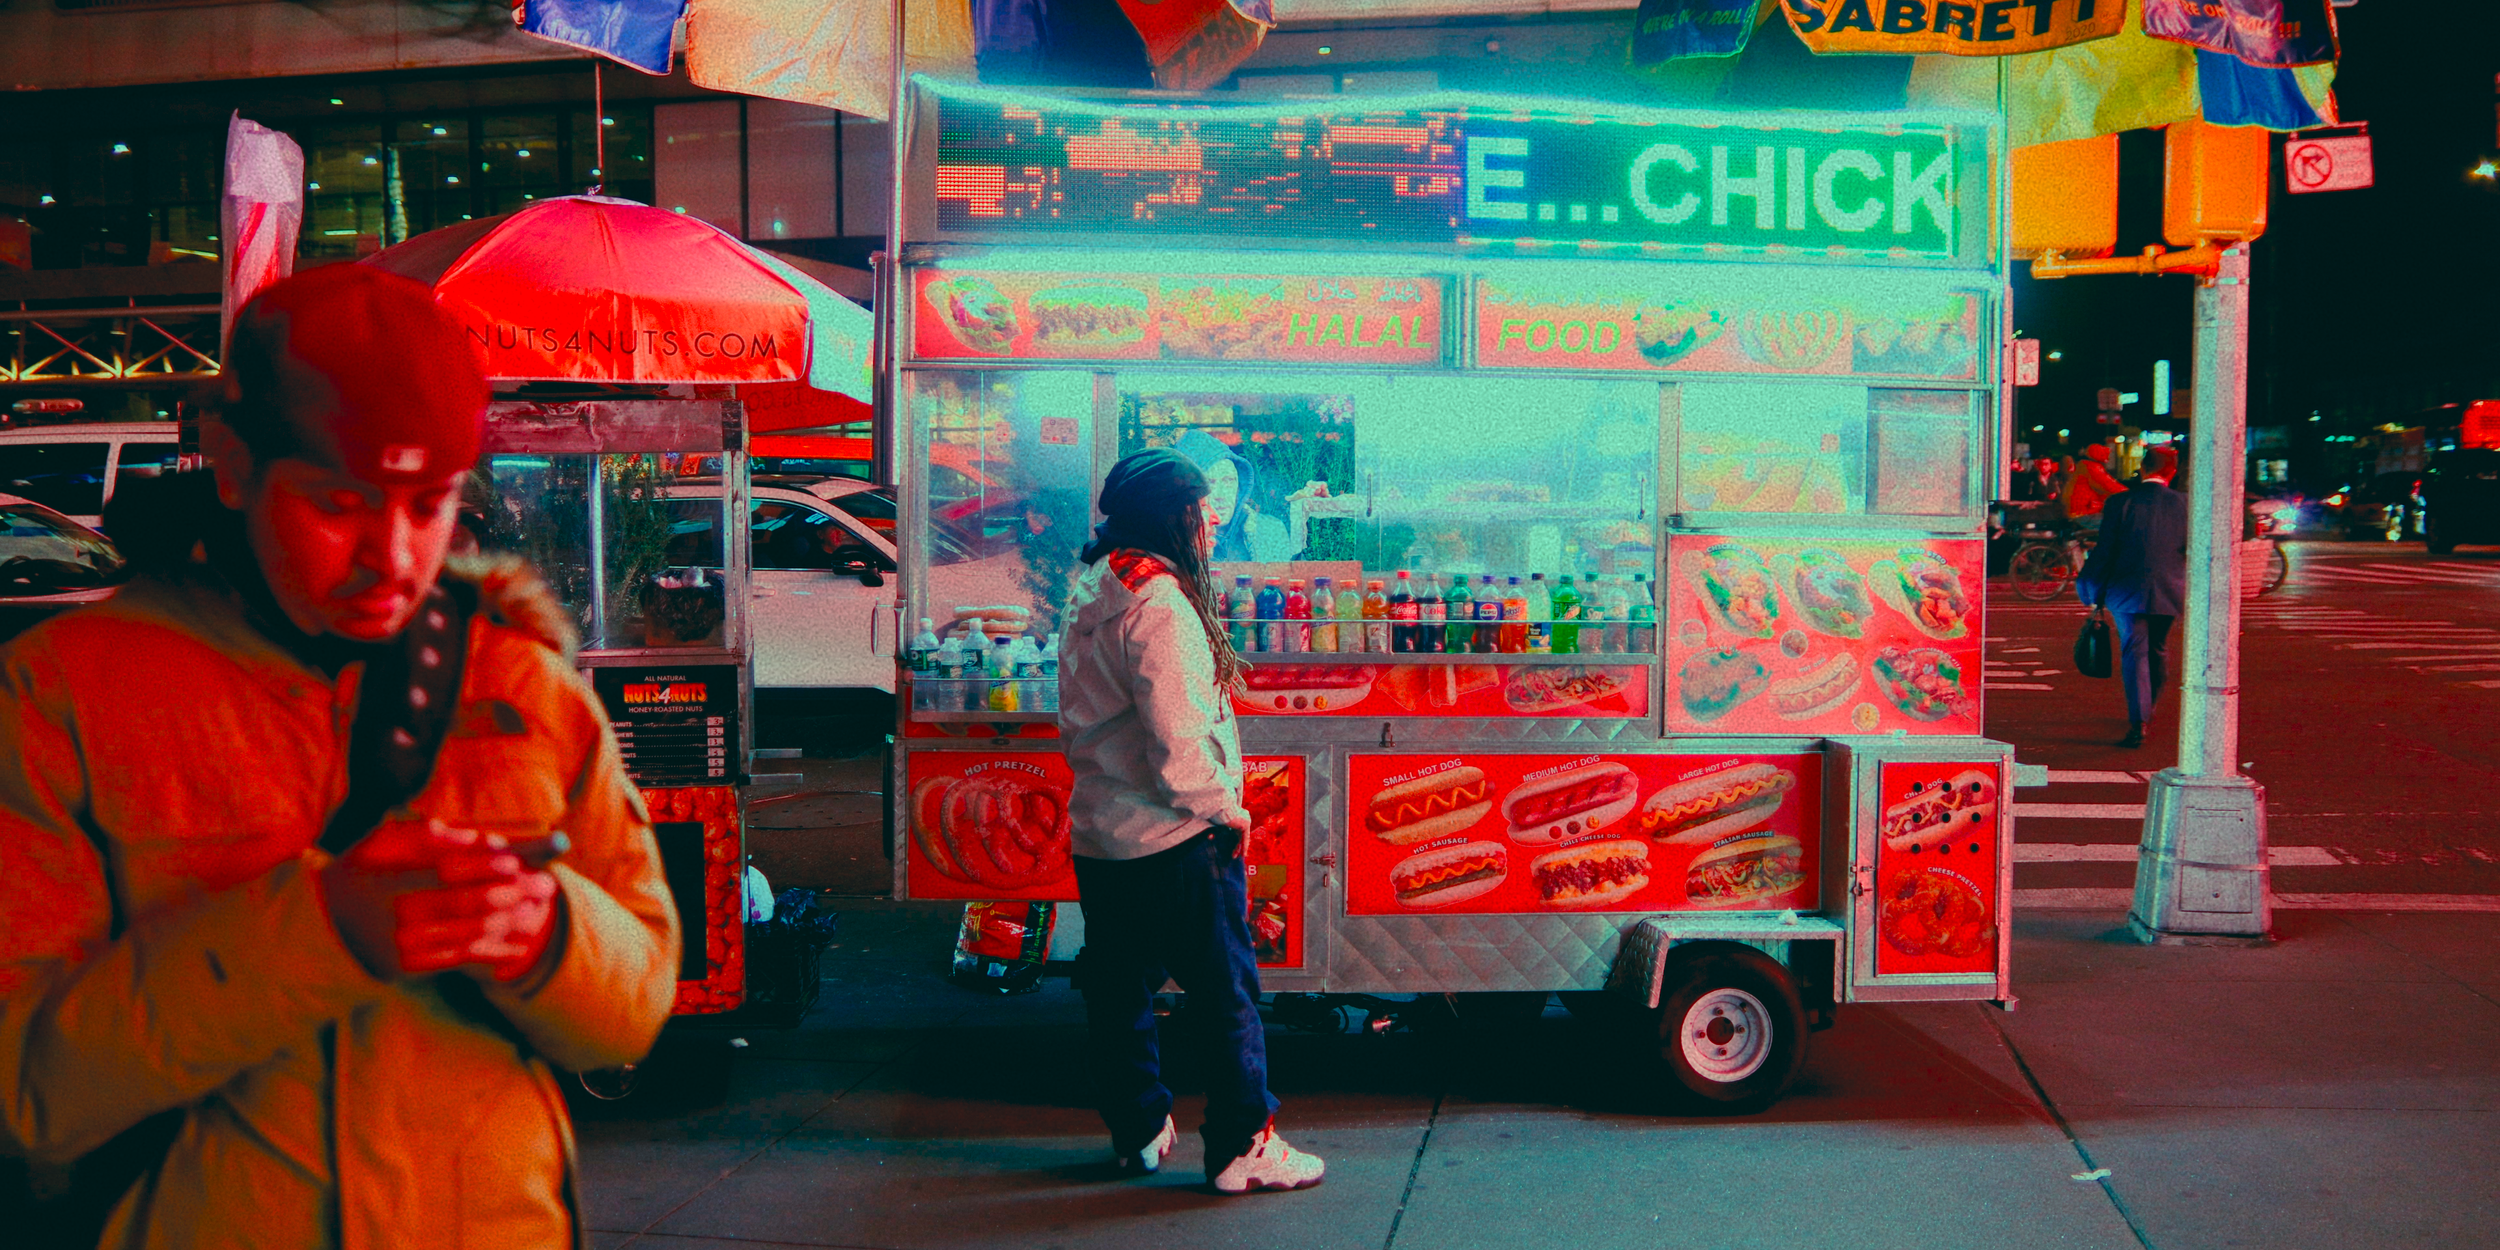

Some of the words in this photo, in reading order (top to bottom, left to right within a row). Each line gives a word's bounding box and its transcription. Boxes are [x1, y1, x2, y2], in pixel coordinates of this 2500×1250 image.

[1708, 8, 1742, 25] ROLL
[466, 322, 779, 359] NUTS4NUTS.COM
[1287, 313, 1433, 349] HALAL
[1497, 318, 1621, 354] FOOD
[964, 762, 989, 777] HOT
[994, 761, 1047, 778] PRETZEL
[1383, 771, 1416, 787] SMALL
[1417, 764, 1438, 777] HOT
[1440, 758, 1462, 771] DOG
[1522, 766, 1558, 782] MEDIUM
[1559, 760, 1578, 772] HOT
[1580, 754, 1601, 766] DOG
[1678, 767, 1704, 781] LARGE
[1704, 763, 1721, 773] HOT
[1721, 758, 1740, 769] DOG
[1926, 777, 1943, 790] DOG
[1413, 843, 1429, 855] HOT
[1431, 837, 1468, 848] SAUSAGE
[1560, 838, 1579, 848] CHILI
[1580, 834, 1605, 842] CHEESE
[1713, 834, 1741, 848] ITALIAN
[1742, 830, 1774, 839] SAUSAGE
[1927, 866, 1955, 877] CHEESE
[1956, 873, 1982, 897] PRETZEL
